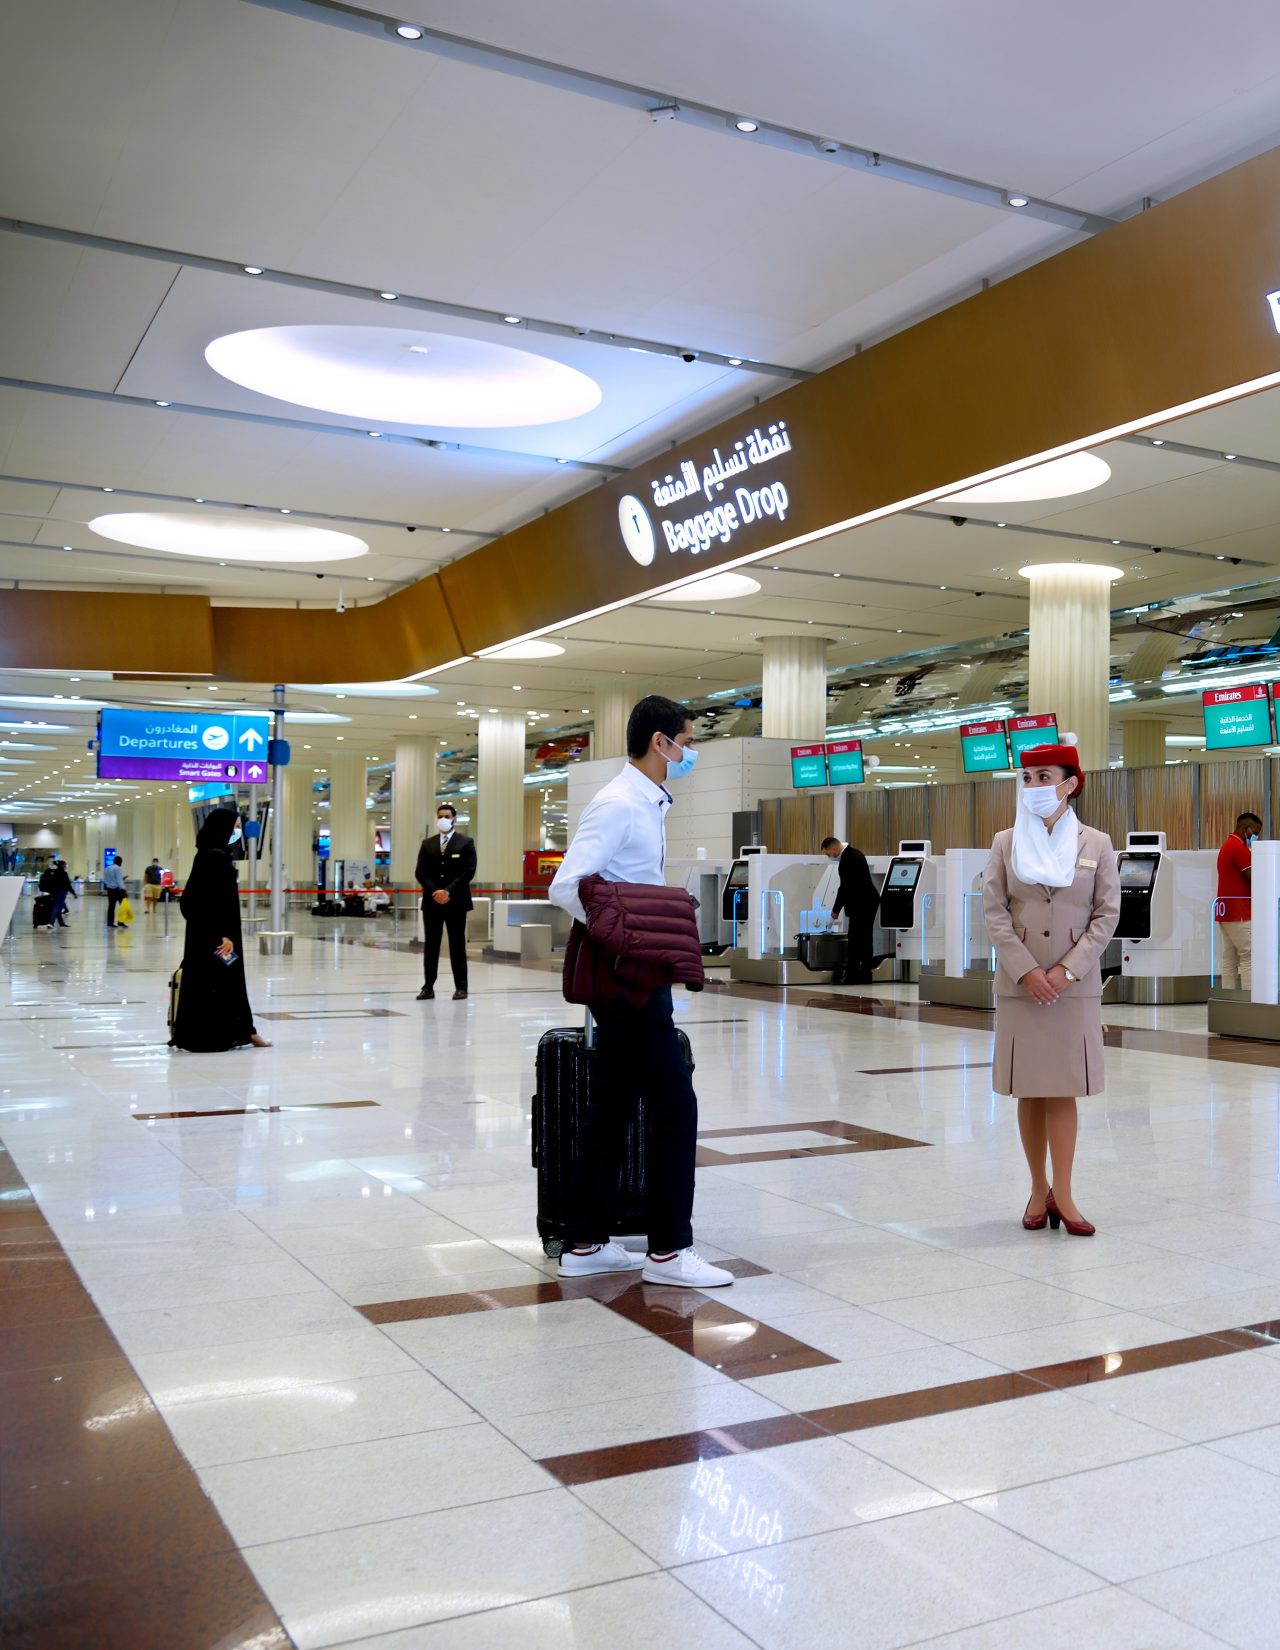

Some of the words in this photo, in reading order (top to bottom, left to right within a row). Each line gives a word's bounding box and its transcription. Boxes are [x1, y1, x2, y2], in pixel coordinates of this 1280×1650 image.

[746, 420, 792, 464] نقطة
[703, 441, 748, 502] تسليم
[651, 460, 700, 507] الأمتعة
[662, 502, 739, 554] Baggage
[735, 481, 789, 523] Drop
[1214, 691, 1242, 703] Emirates
[145, 724, 198, 735] المغادرون
[119, 736, 198, 750] Departures
[179, 769, 200, 777] Smart
[1215, 901, 1226, 917] 10
